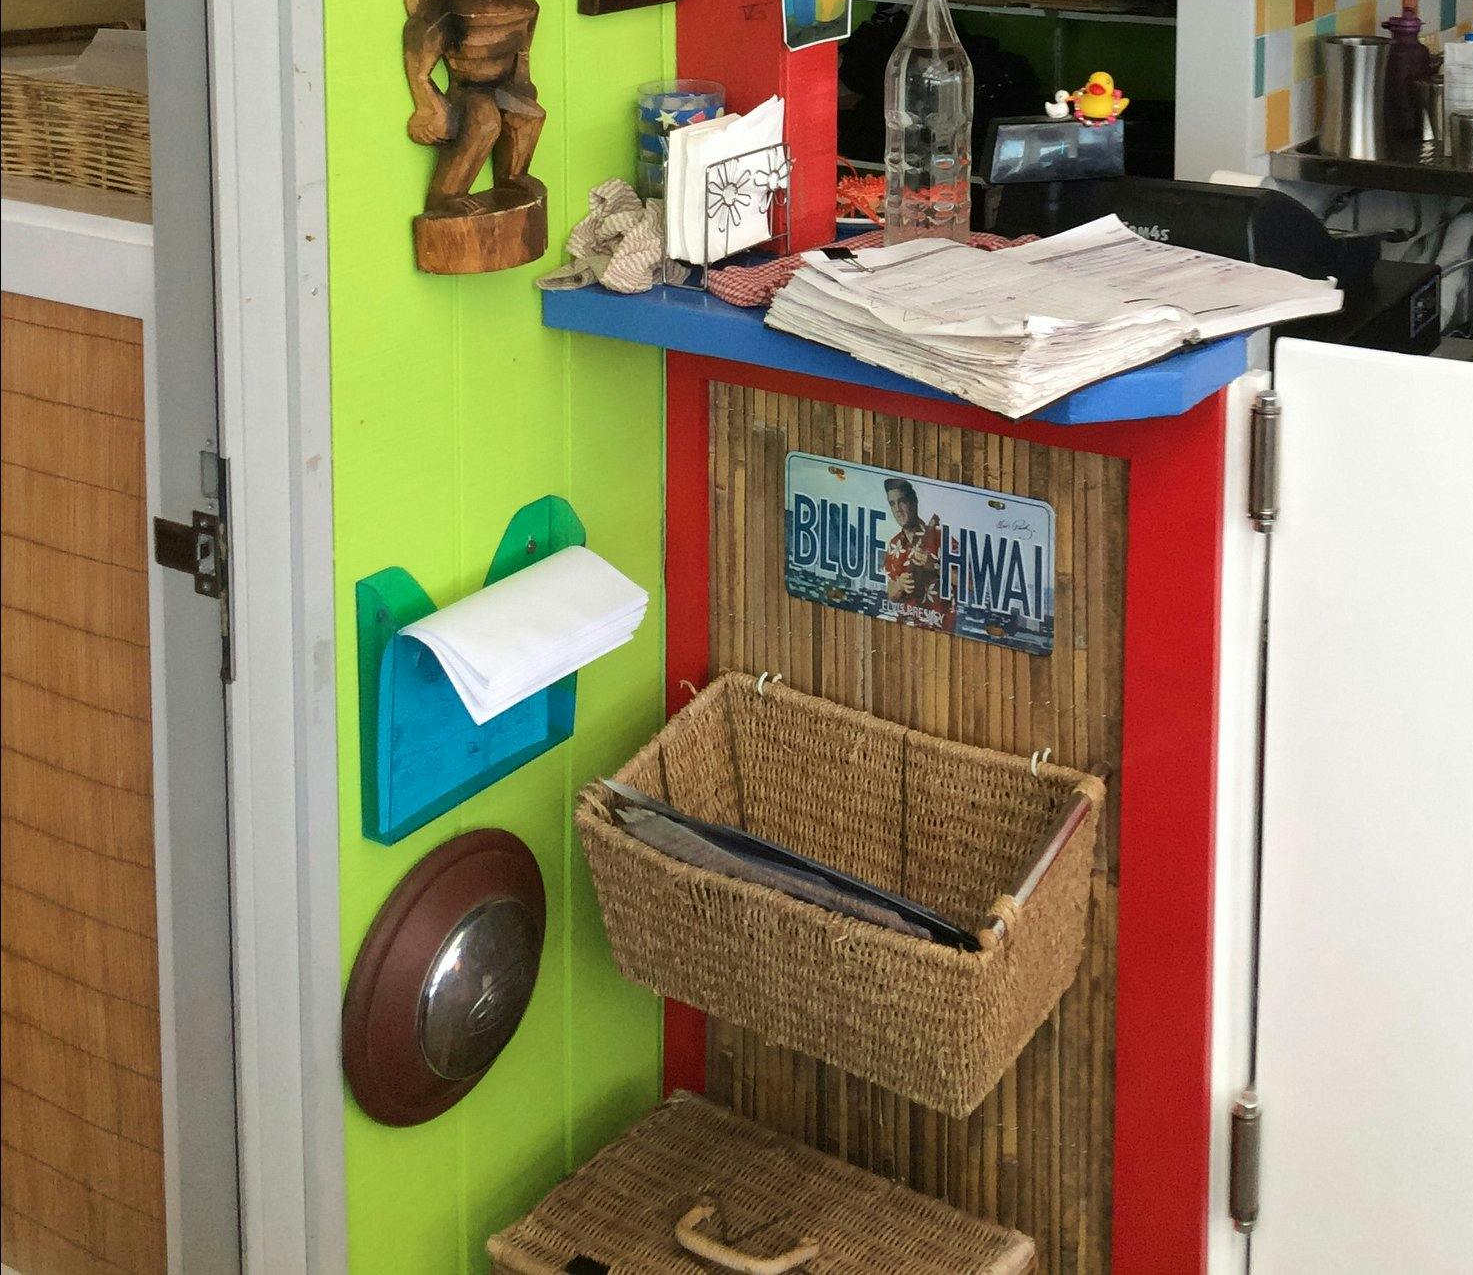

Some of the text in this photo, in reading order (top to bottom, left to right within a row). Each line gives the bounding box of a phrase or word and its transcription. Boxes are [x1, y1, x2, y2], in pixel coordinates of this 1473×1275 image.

[793, 492, 1045, 622] BLUE HWAI
[881, 598, 905, 614] ELVIS
